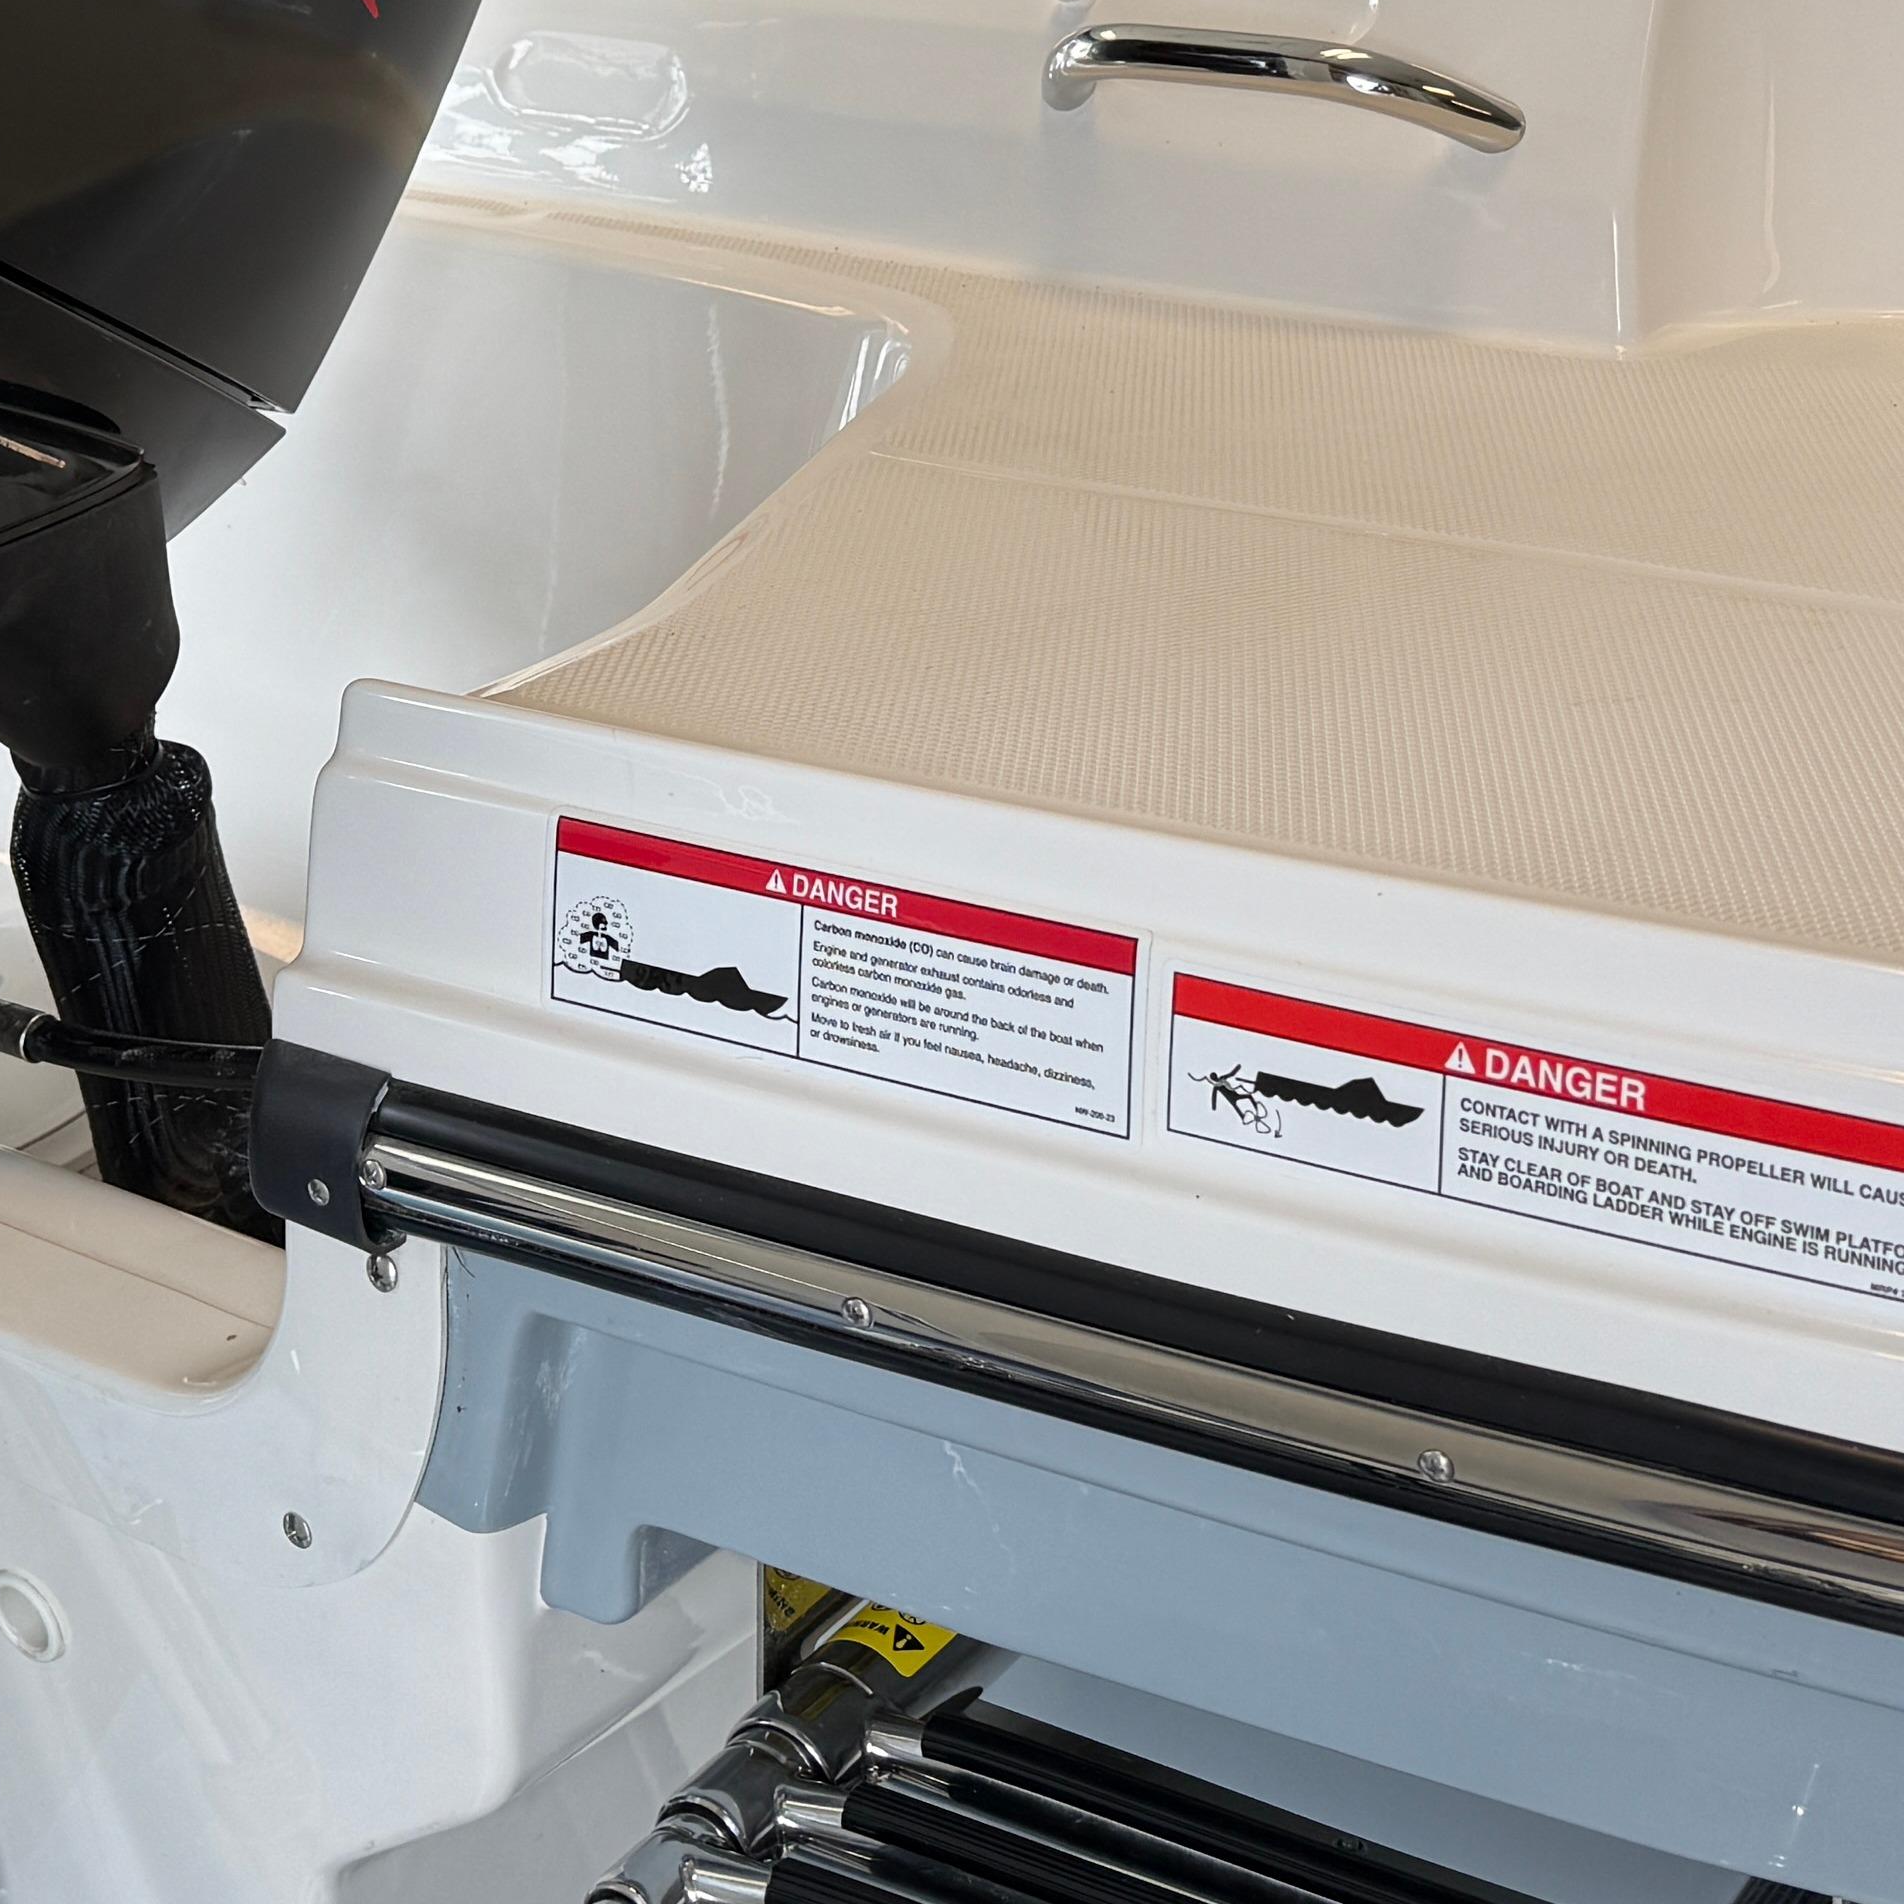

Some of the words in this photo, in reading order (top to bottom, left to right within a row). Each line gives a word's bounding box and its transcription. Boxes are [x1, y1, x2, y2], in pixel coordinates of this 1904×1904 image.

[792, 872, 898, 919] DANGER
[813, 919, 852, 938] Carbon
[854, 930, 907, 950] monoxide
[908, 940, 934, 958] (CO)
[935, 948, 955, 961] can
[956, 953, 988, 968] cause
[990, 958, 1017, 974] brain
[1018, 965, 1061, 986] damage
[1063, 976, 1075, 987] or
[1076, 978, 1109, 995] death.
[813, 940, 847, 958] Engine
[849, 950, 869, 963] and
[869, 955, 919, 974] generator
[919, 966, 960, 984] exhaust
[961, 976, 1006, 994] contains
[1007, 985, 1052, 1004] odorless
[1053, 996, 1075, 1009] and
[857, 967, 892, 983] carbon
[893, 975, 943, 995] monoxide
[944, 987, 967, 1001] gas.
[809, 1028, 821, 1039] or
[822, 1030, 880, 1053] drowsiness.
[811, 975, 848, 994] Carbon
[849, 987, 898, 1006] monoxide
[918, 1001, 932, 1014] be
[933, 1006, 970, 1023] around
[971, 1013, 989, 1027] the
[990, 1017, 1015, 1033] back
[1030, 1026, 1047, 1041] the
[1049, 1030, 1073, 1046] boat
[1075, 1038, 1104, 1053] when
[811, 993, 850, 1010] engines
[851, 1002, 862, 1012] or
[863, 1005, 918, 1026] generators
[919, 1018, 937, 1031] are
[938, 1023, 979, 1043] running.
[811, 1011, 838, 1028] Move
[839, 1019, 850, 1031] to
[852, 1021, 877, 1037] fresh
[878, 1029, 892, 1040] air
[902, 1036, 921, 1048] you
[923, 1038, 943, 1052] feel
[1485, 1047, 1646, 1112] DANGER
[1459, 1117, 1534, 1147] SERIOUS
[1538, 1134, 1600, 1162] INJURY
[1603, 1149, 1630, 1169] OR
[1634, 1156, 1698, 1184] DEATH.
[1460, 1097, 1541, 1127] CONTACT
[1544, 1115, 1588, 1139] WITH
[1591, 1126, 1604, 1143] A
[1608, 1129, 1692, 1161] SPINNING
[1696, 1148, 1805, 1186] PROPELLER
[1810, 1172, 1855, 1196] WILL
[1457, 1146, 1500, 1168] STAY
[1503, 1157, 1562, 1183] CLEAR
[1566, 1171, 1592, 1188] OF
[1595, 1177, 1645, 1201] BOAT
[1647, 1190, 1687, 1211] AND
[1690, 1199, 1736, 1222] STAY
[1739, 1210, 1777, 1230] OFF
[1780, 1219, 1831, 1243] SWIM
[1457, 1162, 1494, 1183] AND
[1497, 1171, 1588, 1205] BOARDING
[1592, 1193, 1664, 1222] LADDER
[1668, 1210, 1725, 1236] WHILE
[1729, 1223, 1797, 1252] ENGINE
[1802, 1240, 1819, 1257] IS
